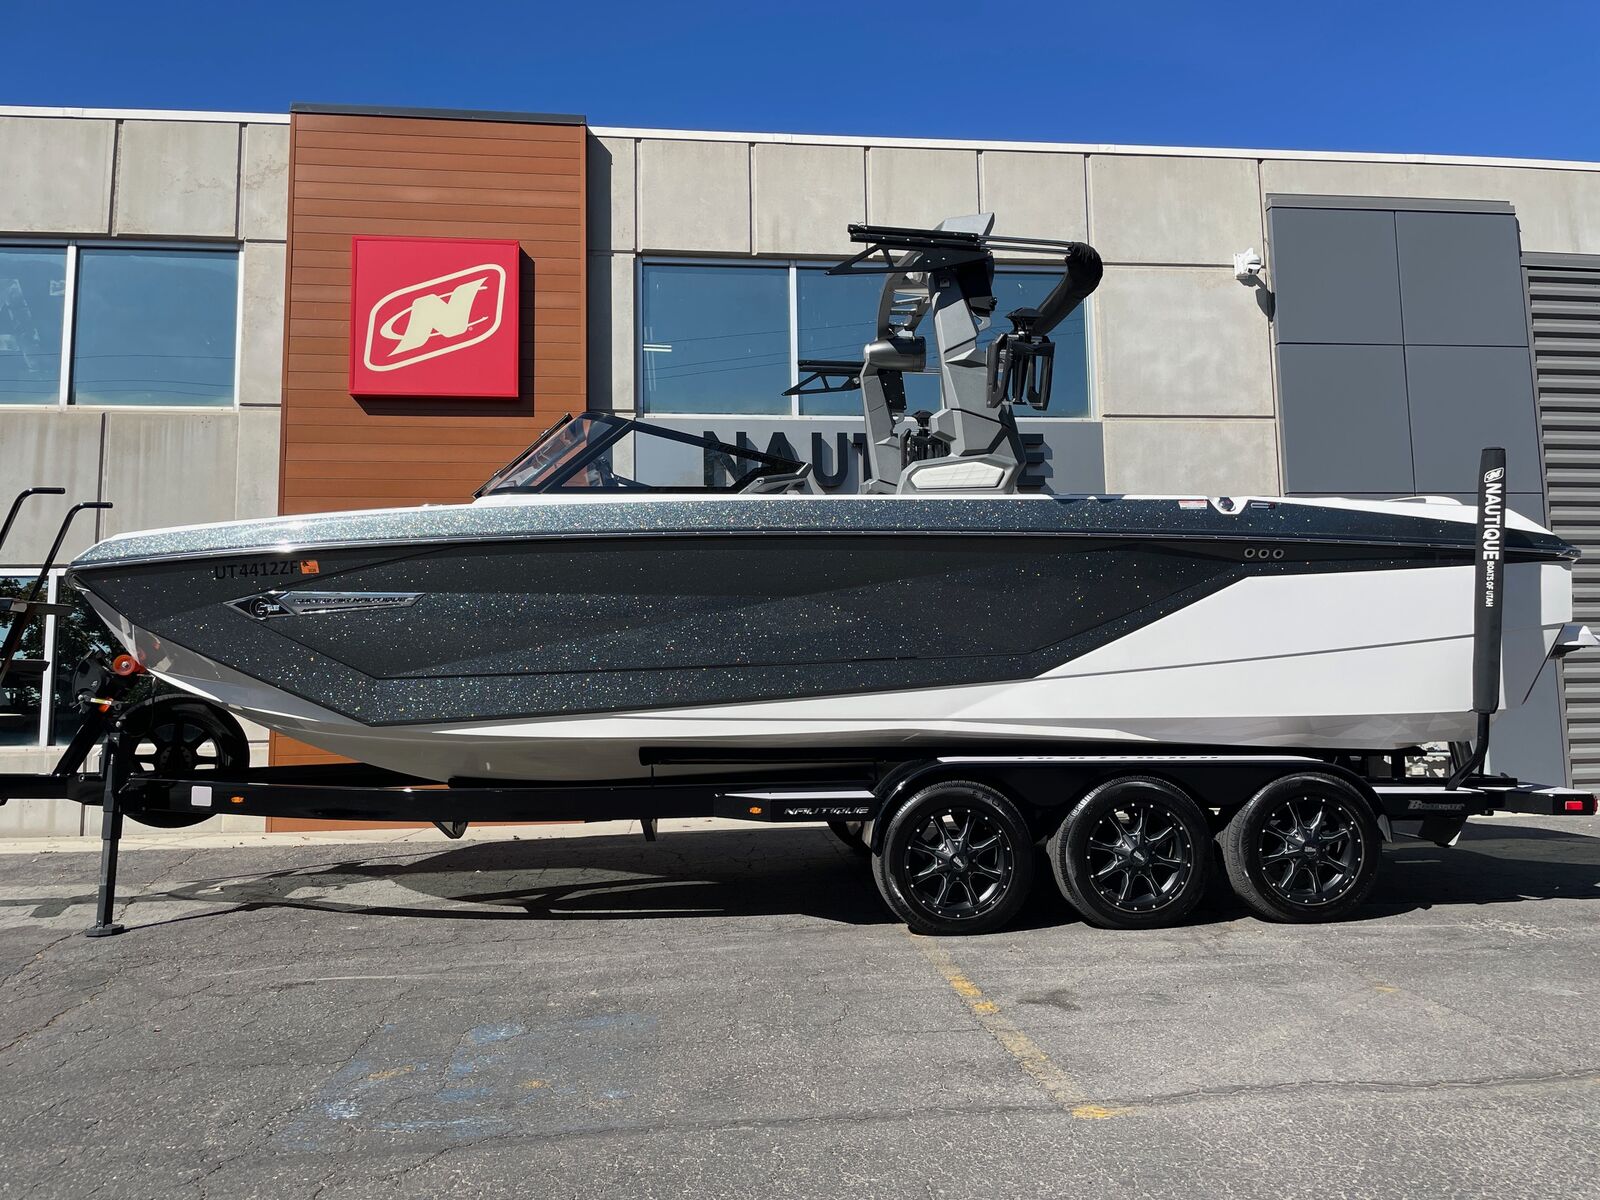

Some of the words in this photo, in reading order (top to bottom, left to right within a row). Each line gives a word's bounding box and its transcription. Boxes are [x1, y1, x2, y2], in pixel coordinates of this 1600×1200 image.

[703, 430, 1046, 488] NAUTE
[1483, 483, 1502, 560] NAUTIQUE
[1486, 561, 1495, 581] BOATS
[1486, 581, 1494, 590] OF
[1485, 591, 1494, 607] UTAH
[784, 806, 870, 816] NAUTIQUE
